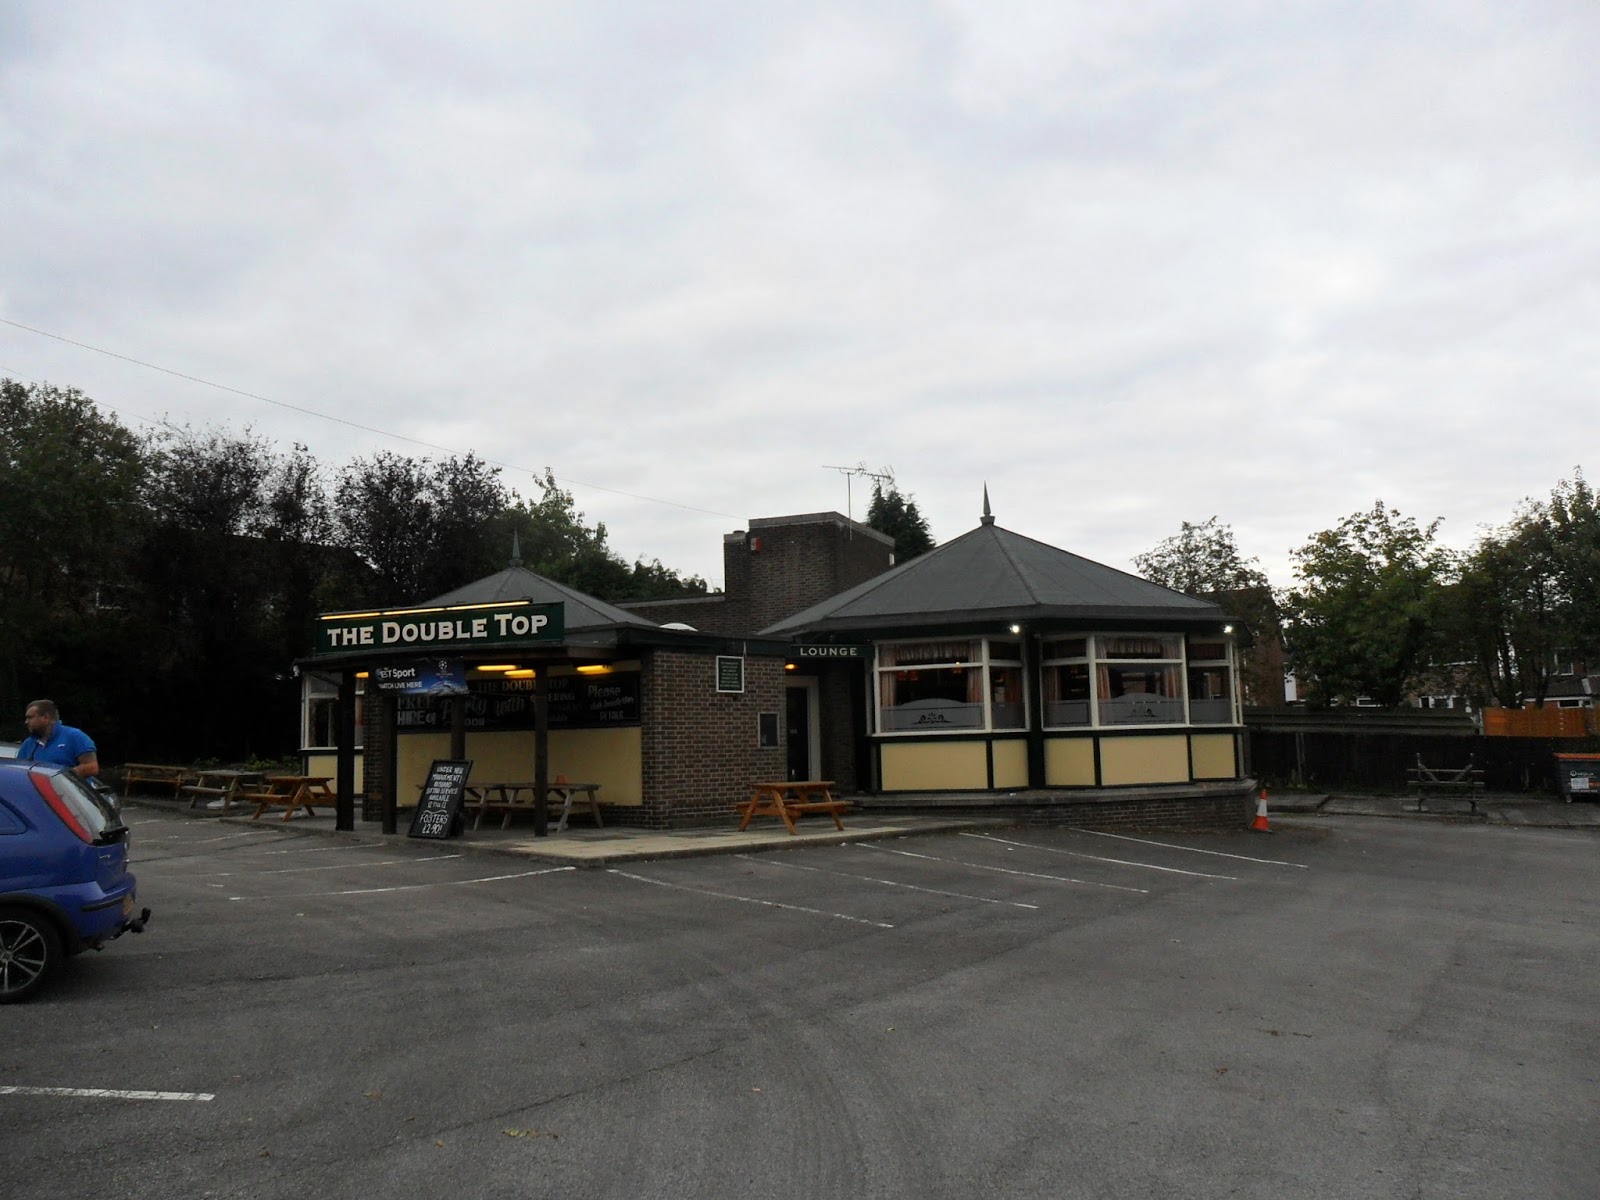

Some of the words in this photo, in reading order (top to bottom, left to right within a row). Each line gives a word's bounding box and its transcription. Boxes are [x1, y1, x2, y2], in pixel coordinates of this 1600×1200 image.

[327, 625, 375, 647] THE
[381, 618, 488, 644] DOUBLE
[493, 613, 548, 637] TOP
[800, 647, 858, 656] LOUNGE
[392, 667, 416, 679] Sport
[406, 681, 423, 689] HERE
[587, 684, 622, 698] Please
[397, 710, 426, 726] HIRE
[420, 813, 448, 824] FOSTERS
